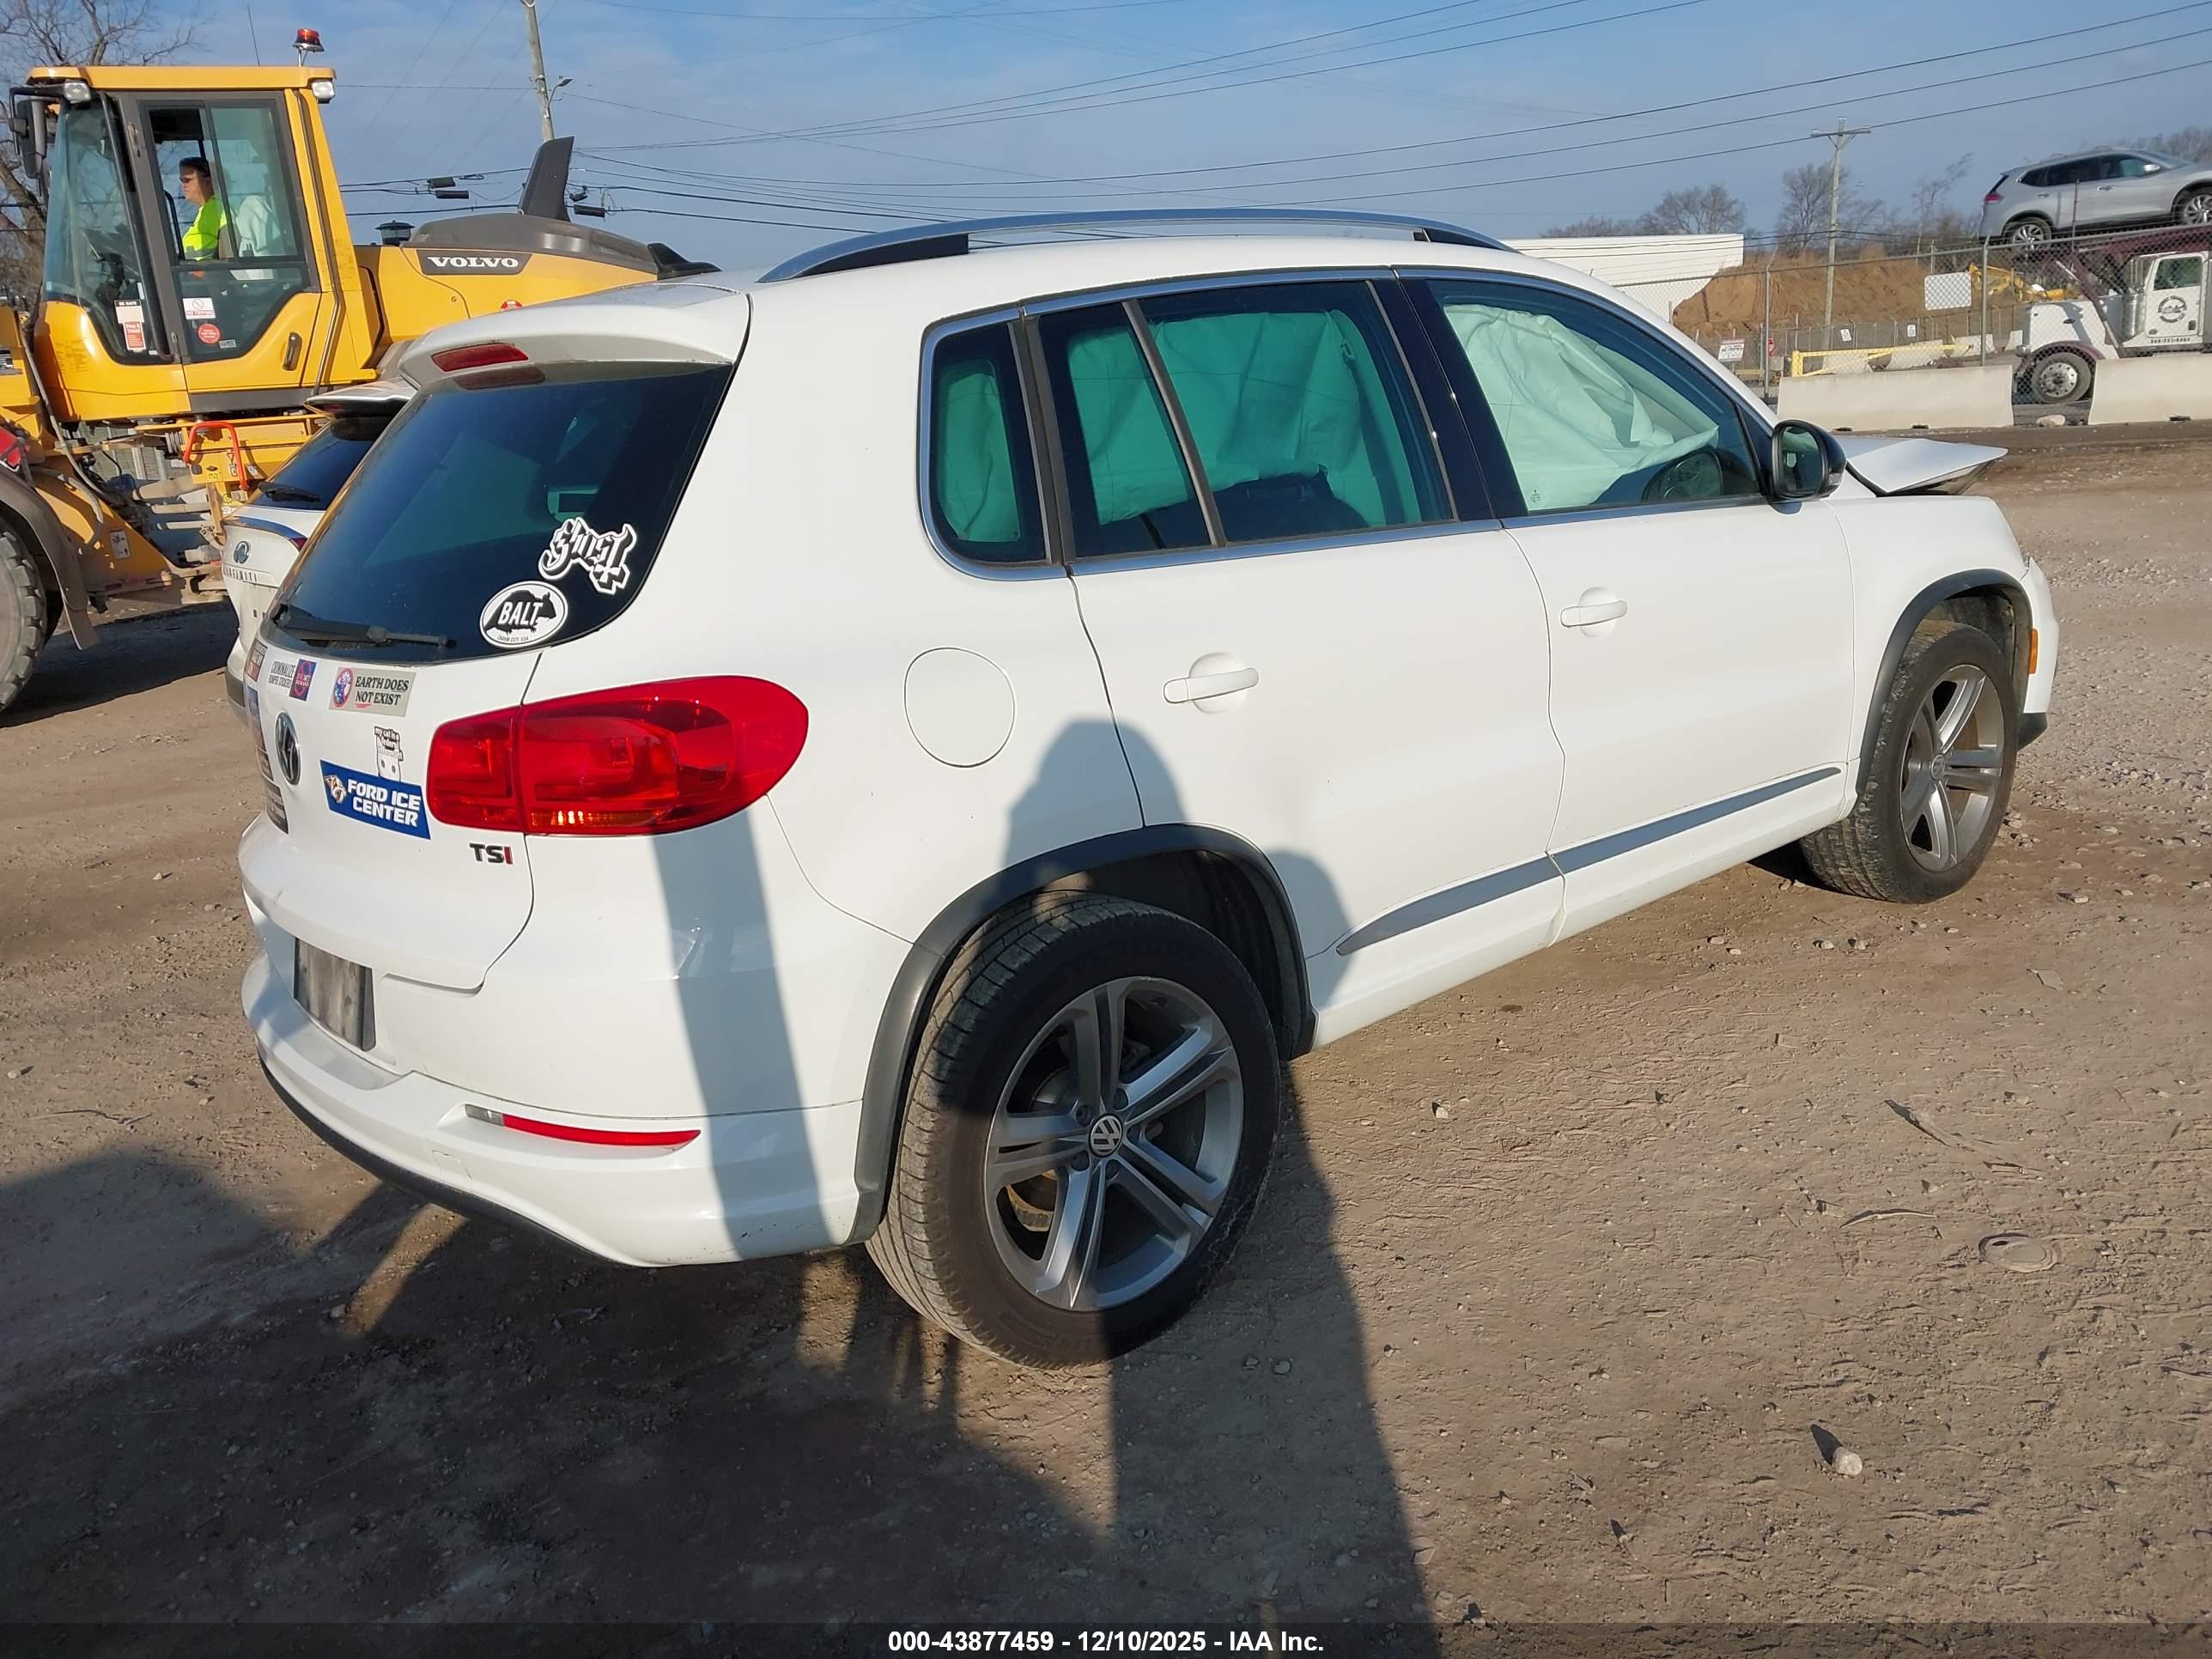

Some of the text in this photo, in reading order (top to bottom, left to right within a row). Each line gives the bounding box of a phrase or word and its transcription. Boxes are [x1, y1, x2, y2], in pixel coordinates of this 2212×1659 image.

[428, 257, 519, 268] VOLVO
[497, 601, 544, 626] BALT
[355, 676, 410, 691] EARTH DOES
[356, 690, 401, 706] NOT EXIST
[347, 778, 422, 811] FORD ICE
[353, 796, 418, 827] CENTER
[469, 842, 514, 866] TSI
